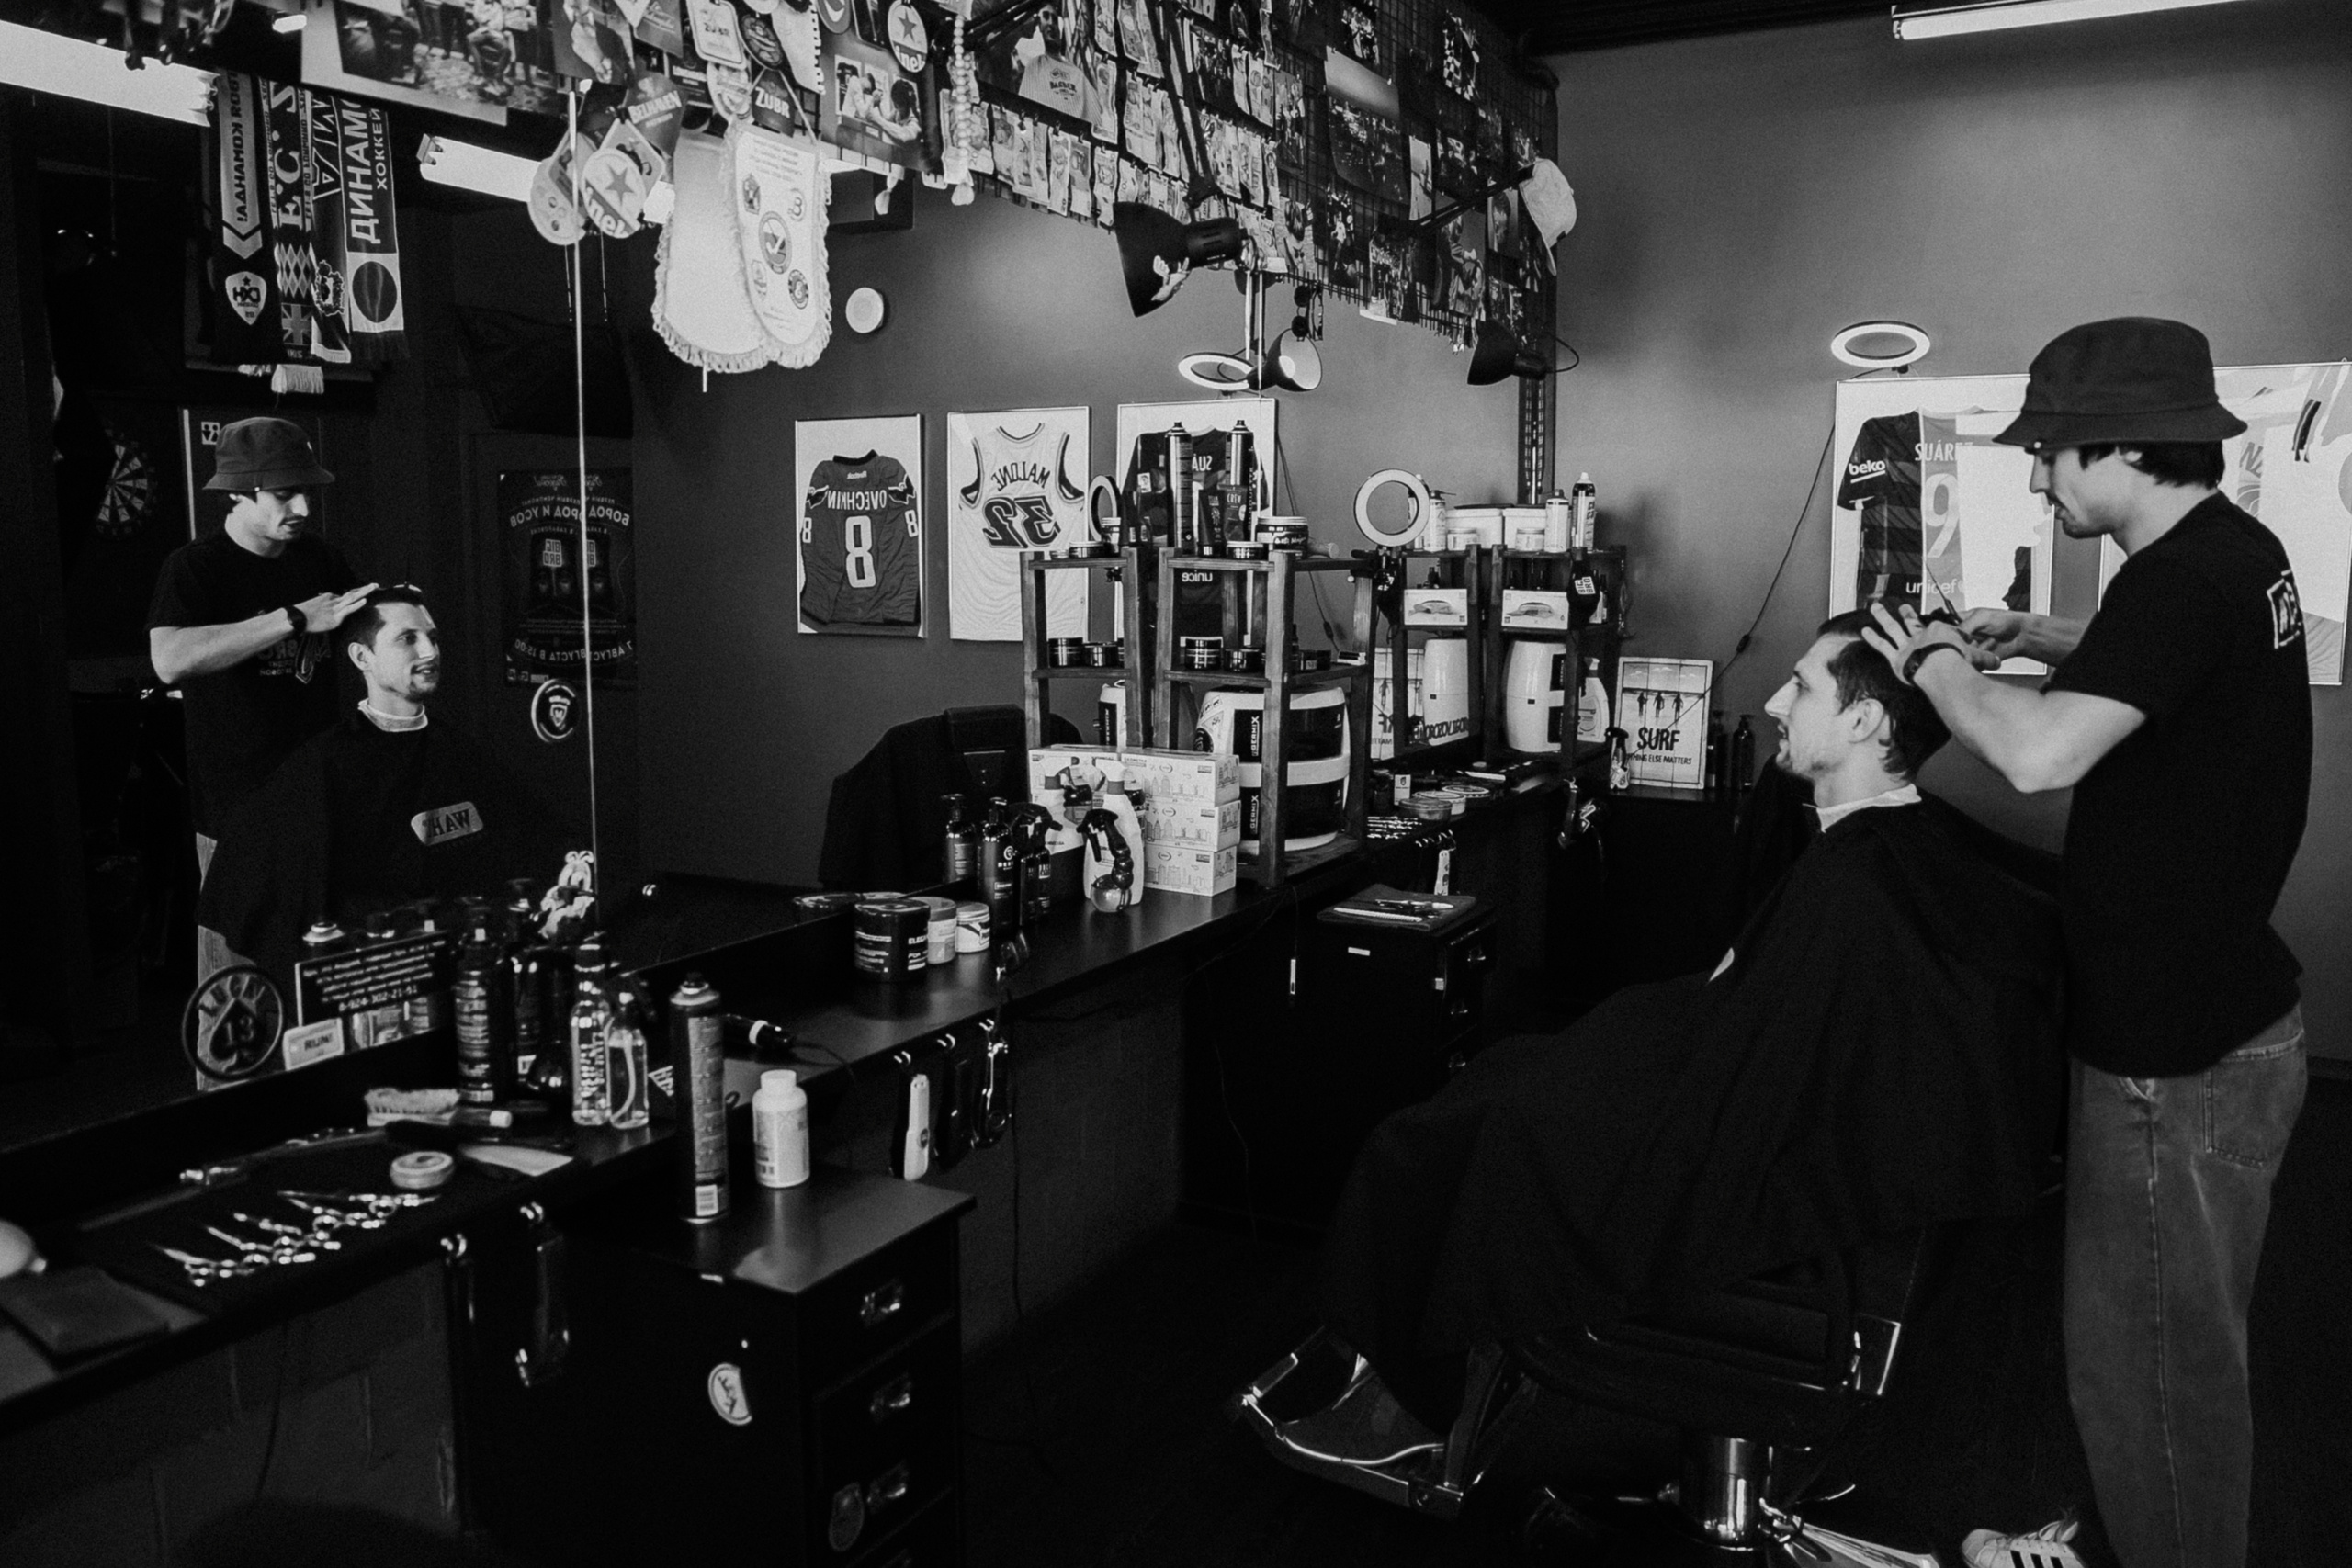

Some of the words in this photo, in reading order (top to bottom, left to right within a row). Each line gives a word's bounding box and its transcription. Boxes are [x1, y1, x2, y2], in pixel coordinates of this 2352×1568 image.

[754, 86, 790, 118] ZUBR
[370, 108, 388, 190] ХОККЕЙ
[340, 98, 381, 244] ДИНАМ
[1849, 460, 1886, 476] beko
[1227, 491, 1241, 504] CREW
[1925, 473, 1960, 558] 9
[1577, 581, 1586, 593] BIG
[1584, 578, 1594, 593] BRO
[1906, 580, 1955, 593] unicef
[1250, 716, 1260, 750] GERMIX
[1637, 727, 1680, 751] SURF
[1648, 754, 1662, 763] ELSE
[1663, 756, 1692, 765] MATTERS
[1250, 795, 1259, 829] GERMIX
[226, 1016, 254, 1046] 13
